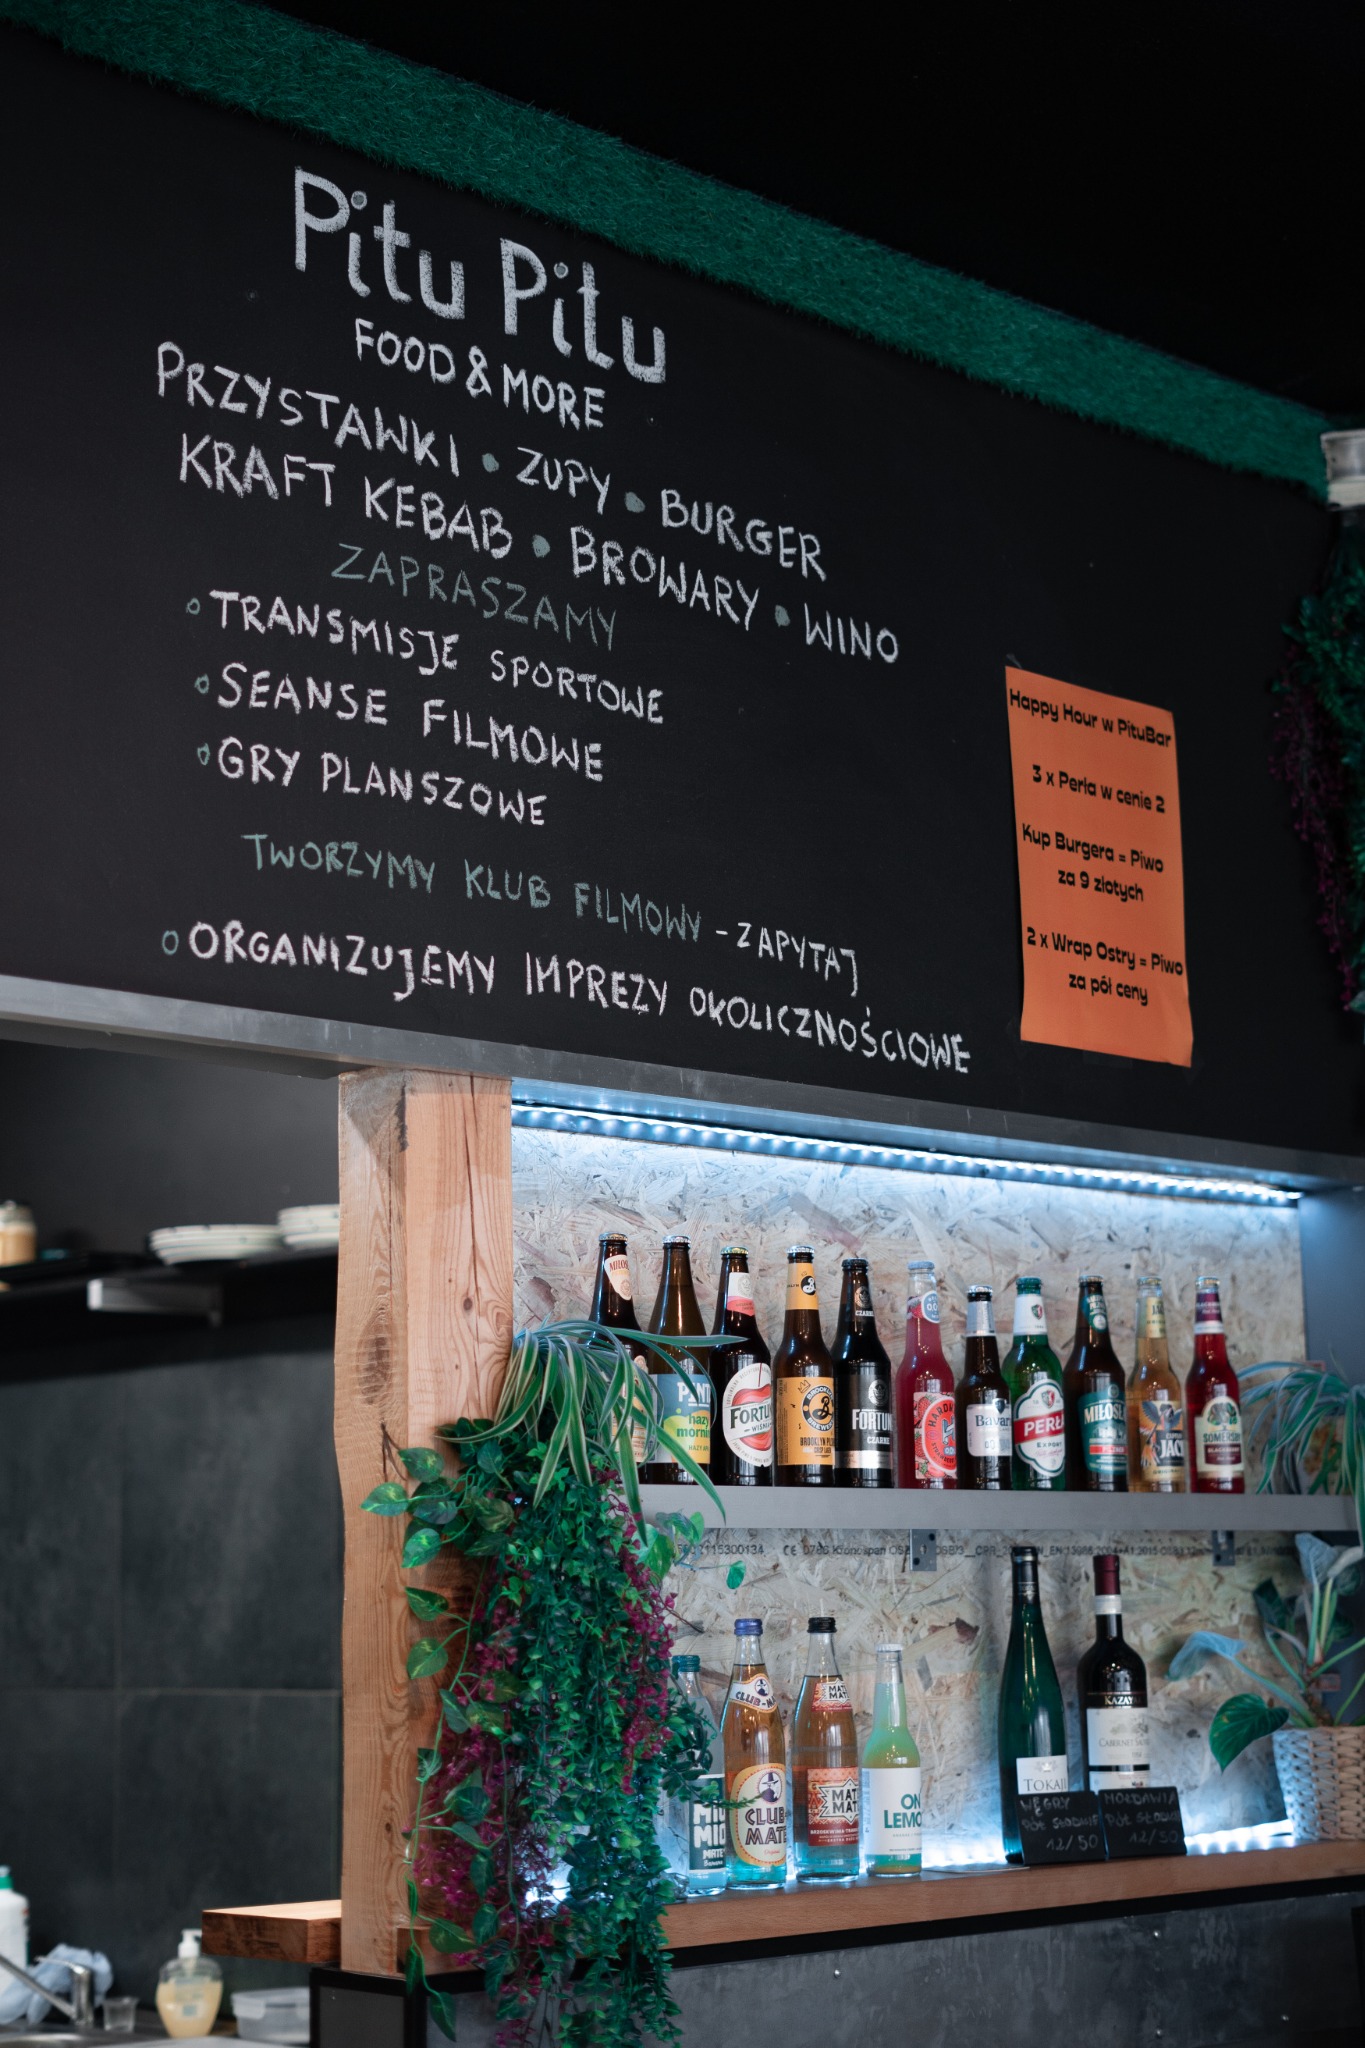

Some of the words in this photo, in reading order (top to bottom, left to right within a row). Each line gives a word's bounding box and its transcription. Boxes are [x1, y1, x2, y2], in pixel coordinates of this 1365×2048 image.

[295, 167, 465, 320] Pitu
[499, 237, 666, 383] Pitu
[355, 318, 455, 383] FOOD
[466, 346, 492, 398] &
[502, 363, 606, 429] MORE
[156, 341, 460, 477] PRZYSTAWKI
[516, 446, 611, 514] ZUPY
[660, 489, 827, 581] BURGER
[179, 433, 336, 507] KRAFT
[363, 476, 513, 560] KEBAB
[569, 525, 760, 631] BROWARY
[804, 602, 899, 663] WINO
[331, 542, 617, 651] ZAPRASZAMY
[209, 589, 460, 675] TRANSMISJE
[490, 649, 664, 724] SPORTOWE
[217, 661, 388, 725] SEANSE
[423, 699, 603, 782] FILMOWE
[1009, 688, 1059, 723] Happy
[1063, 703, 1098, 729] Hour
[1102, 717, 1114, 733] w
[1117, 718, 1172, 748] PituBar
[217, 736, 301, 786] GRY
[321, 752, 548, 826] PLANSZOWE
[1032, 764, 1042, 783] 3
[1046, 771, 1055, 787] x
[1058, 770, 1097, 797] Perła
[1100, 785, 1113, 801] w
[1116, 788, 1152, 811] cenie
[1155, 795, 1166, 814] 2
[1021, 822, 1051, 851] Kup
[1054, 831, 1115, 862] Burgera
[1118, 853, 1127, 863] =
[1130, 849, 1164, 873] Piwo
[1057, 869, 1076, 887] za
[1079, 871, 1090, 889] 9
[1093, 875, 1144, 902] złotych
[241, 834, 436, 893] TWORZYMY
[464, 859, 551, 908] KLUB
[573, 882, 701, 942] FILMOWY
[736, 921, 858, 997] ZAPYTAJ
[1026, 926, 1037, 946] 2
[1040, 933, 1049, 949] x
[1051, 931, 1093, 961] Wrap
[1096, 941, 1136, 971] Ostry
[1139, 957, 1147, 967] =
[1150, 953, 1184, 976] Piwo
[188, 919, 496, 1002] ORGANIZUJEMY
[525, 952, 668, 1016] IMPREZY
[689, 986, 972, 1074] OKOLICZNOŚCIOWE
[1068, 973, 1087, 991] za
[1090, 975, 1113, 997] pół
[1116, 982, 1149, 1007] ceny
[689, 1414, 709, 1429] hazy
[1104, 1695, 1134, 1705] KAZAY
[1024, 1777, 1068, 1792] TOKAJI
